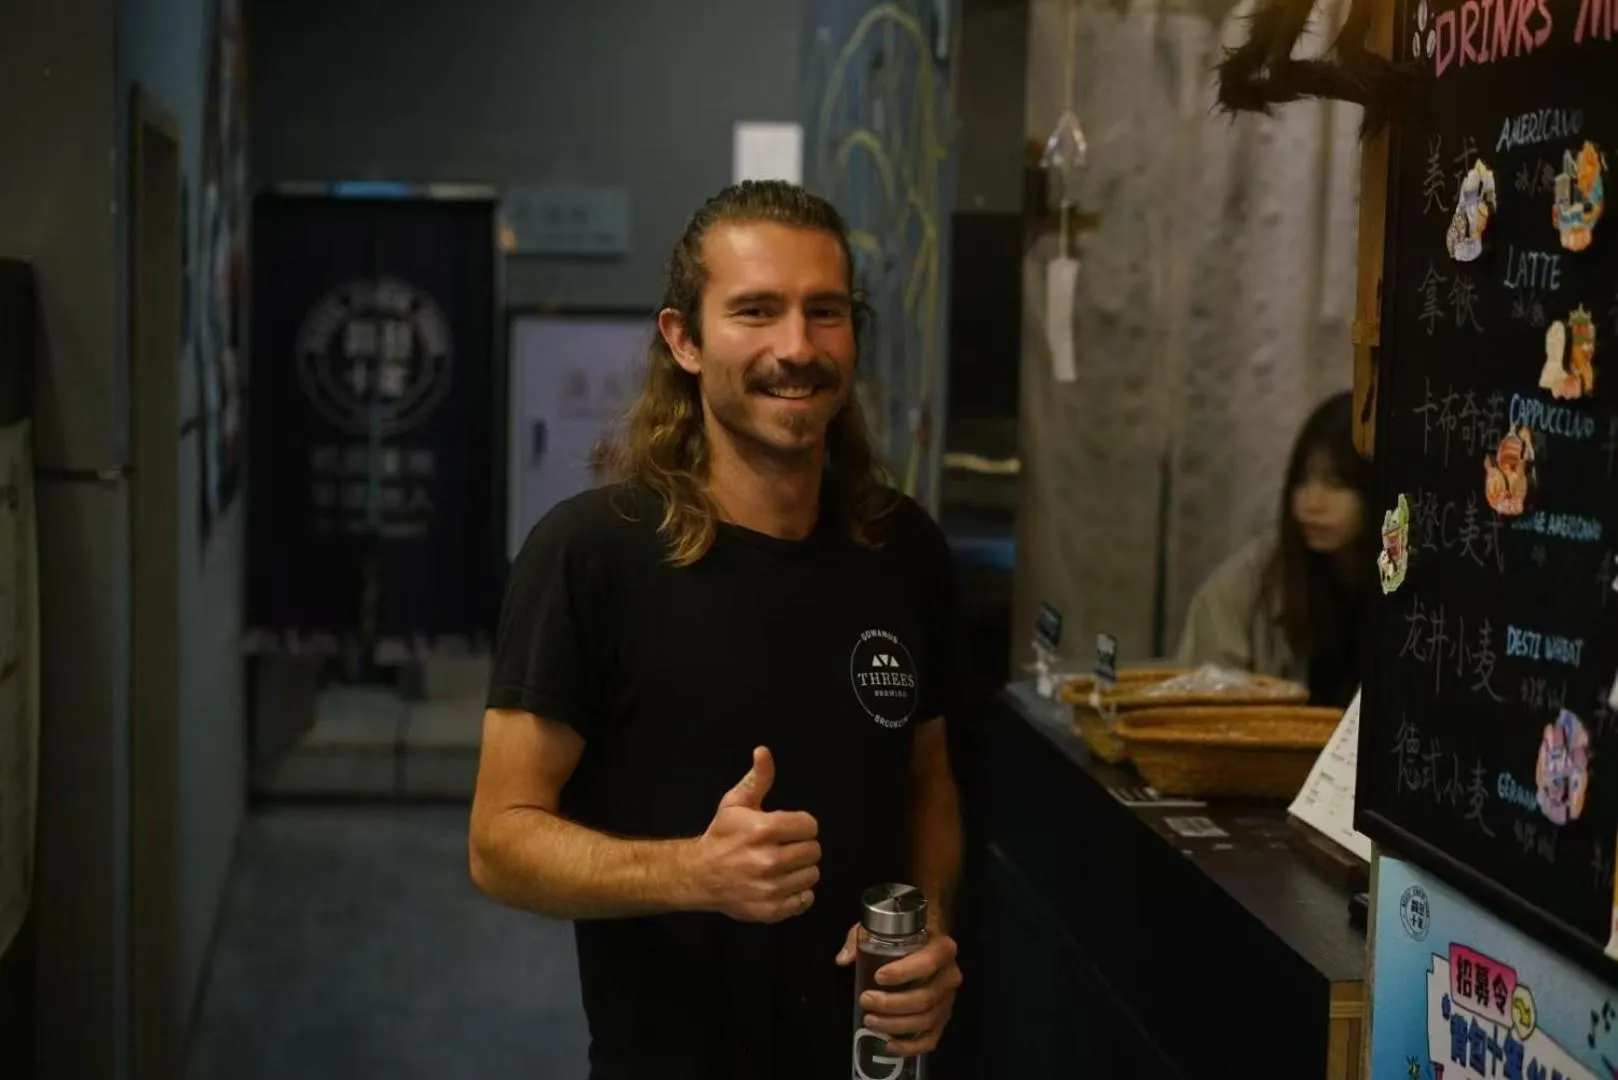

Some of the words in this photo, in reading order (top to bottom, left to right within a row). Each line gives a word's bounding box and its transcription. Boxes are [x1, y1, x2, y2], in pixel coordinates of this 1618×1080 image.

[1435, 0, 1552, 78] DRINKS
[1574, 0, 1618, 45] M
[1496, 108, 1583, 152] AMERICANO
[1417, 260, 1484, 337] 拿铁
[1504, 244, 1562, 291] LATTE
[1413, 376, 1505, 470] 卡布奇诺
[1509, 392, 1595, 439] CAPPUCCINO
[861, 629, 898, 644] GOWANUS
[1398, 593, 1506, 702] 龙井小麦
[857, 672, 915, 687] THREES
[1390, 710, 1496, 838] 德式小麦
[1456, 954, 1510, 1016] 招募令
